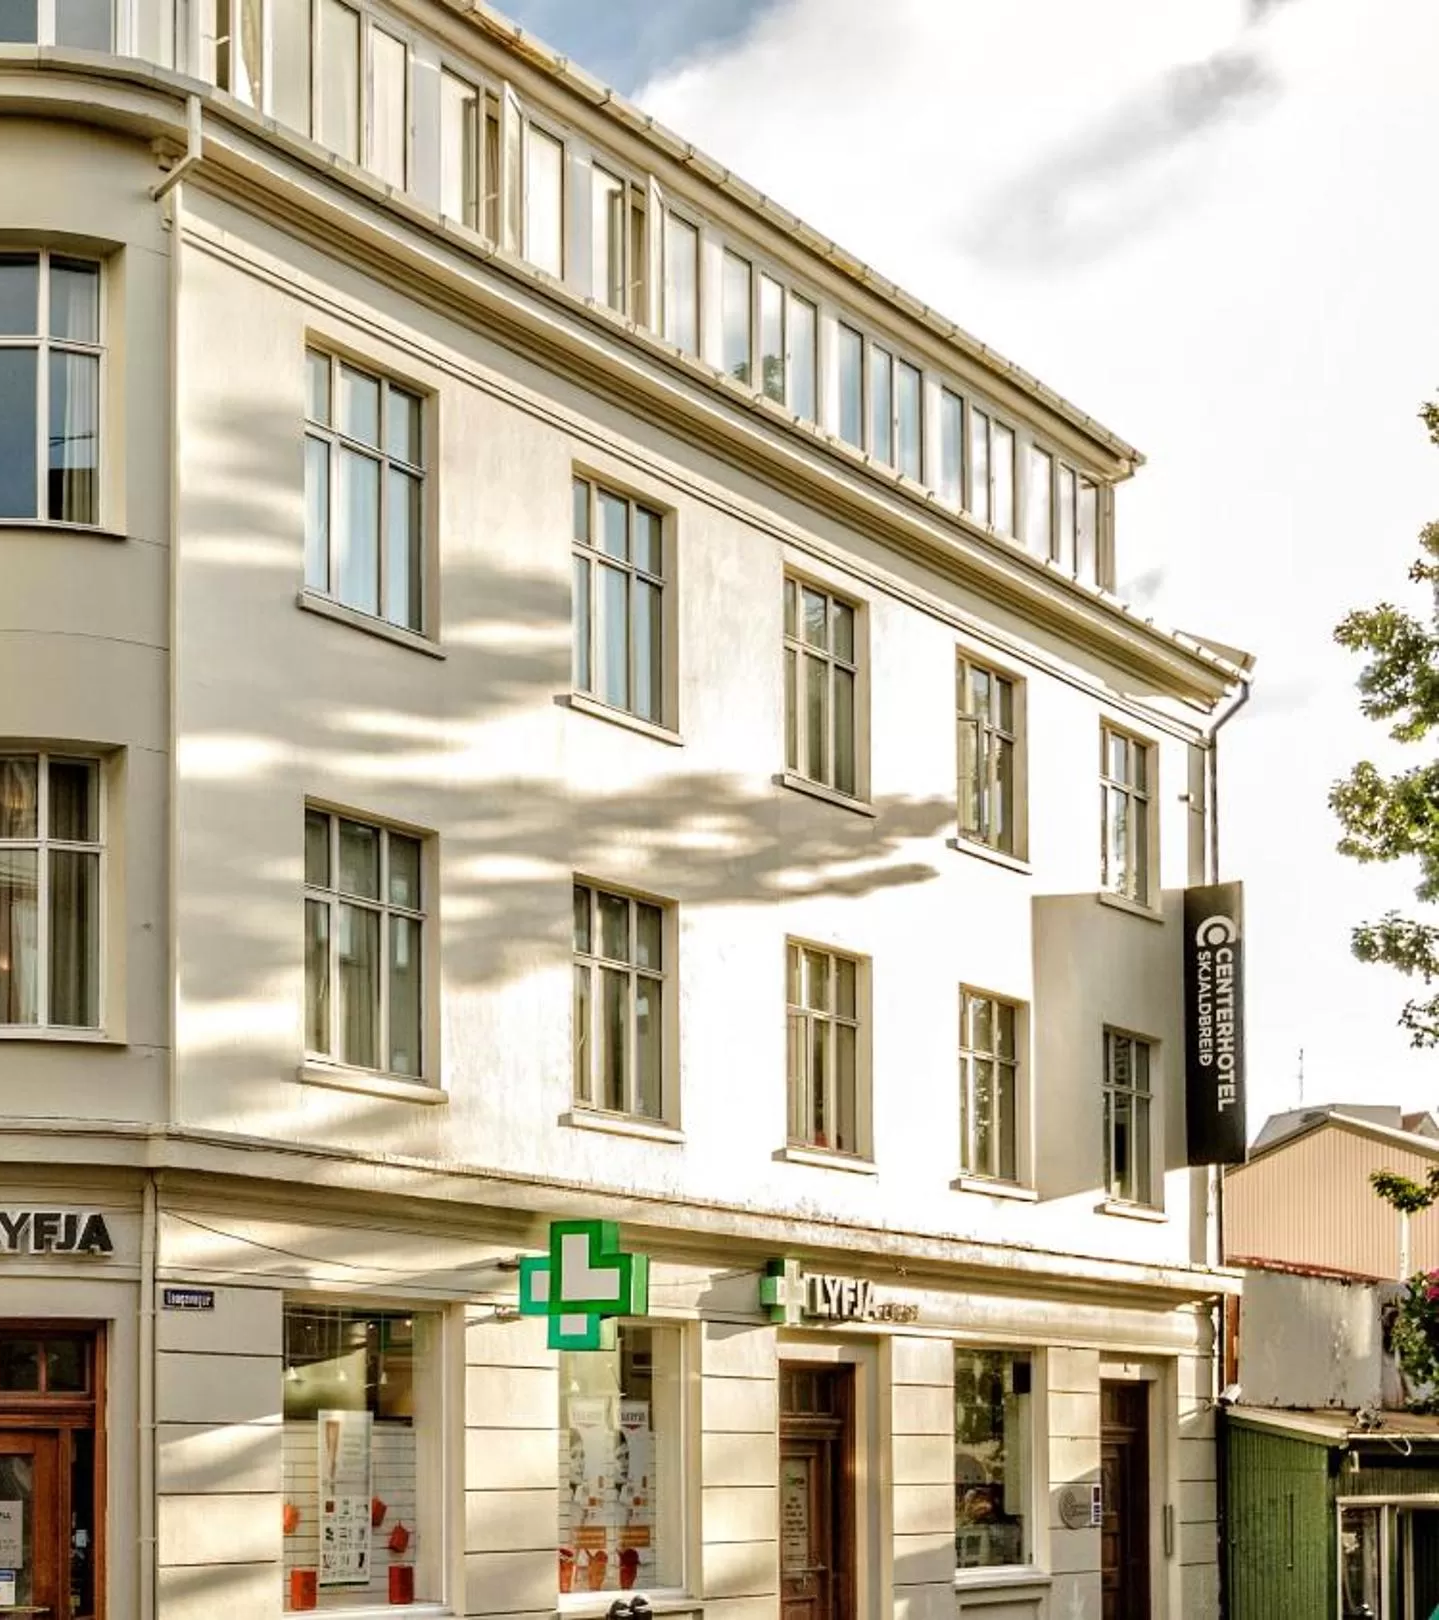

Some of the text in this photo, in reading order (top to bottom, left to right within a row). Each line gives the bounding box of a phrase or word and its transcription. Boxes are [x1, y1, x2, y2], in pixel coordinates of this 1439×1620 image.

[1197, 951, 1213, 1067] SKJALDBREIÐ
[1216, 947, 1236, 1112] CENTERHOTEL
[810, 1273, 880, 1321] LYFJA
